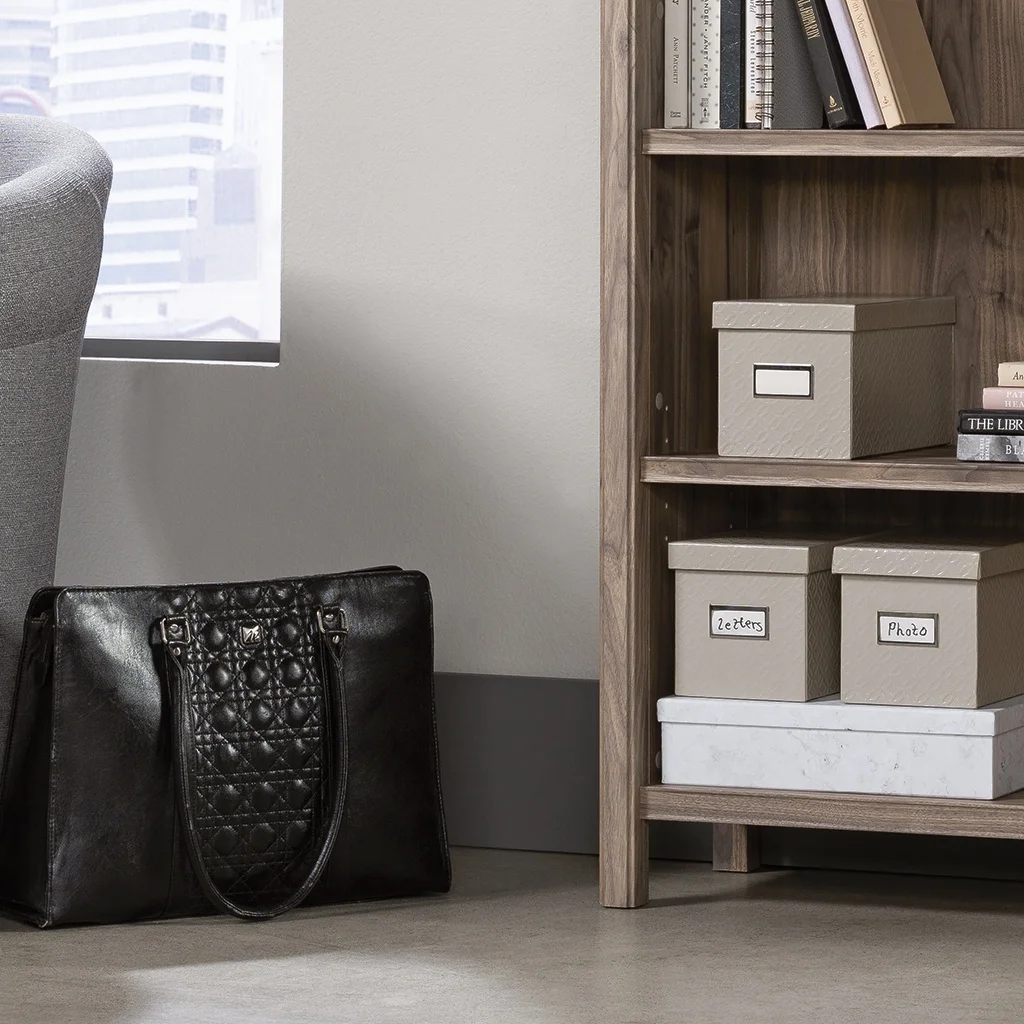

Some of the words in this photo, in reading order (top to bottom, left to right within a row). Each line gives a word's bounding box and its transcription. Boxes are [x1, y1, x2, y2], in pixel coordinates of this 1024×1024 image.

[799, 6, 821, 40] JEOPARDY
[967, 417, 994, 431] THE
[888, 621, 928, 637] Photo
